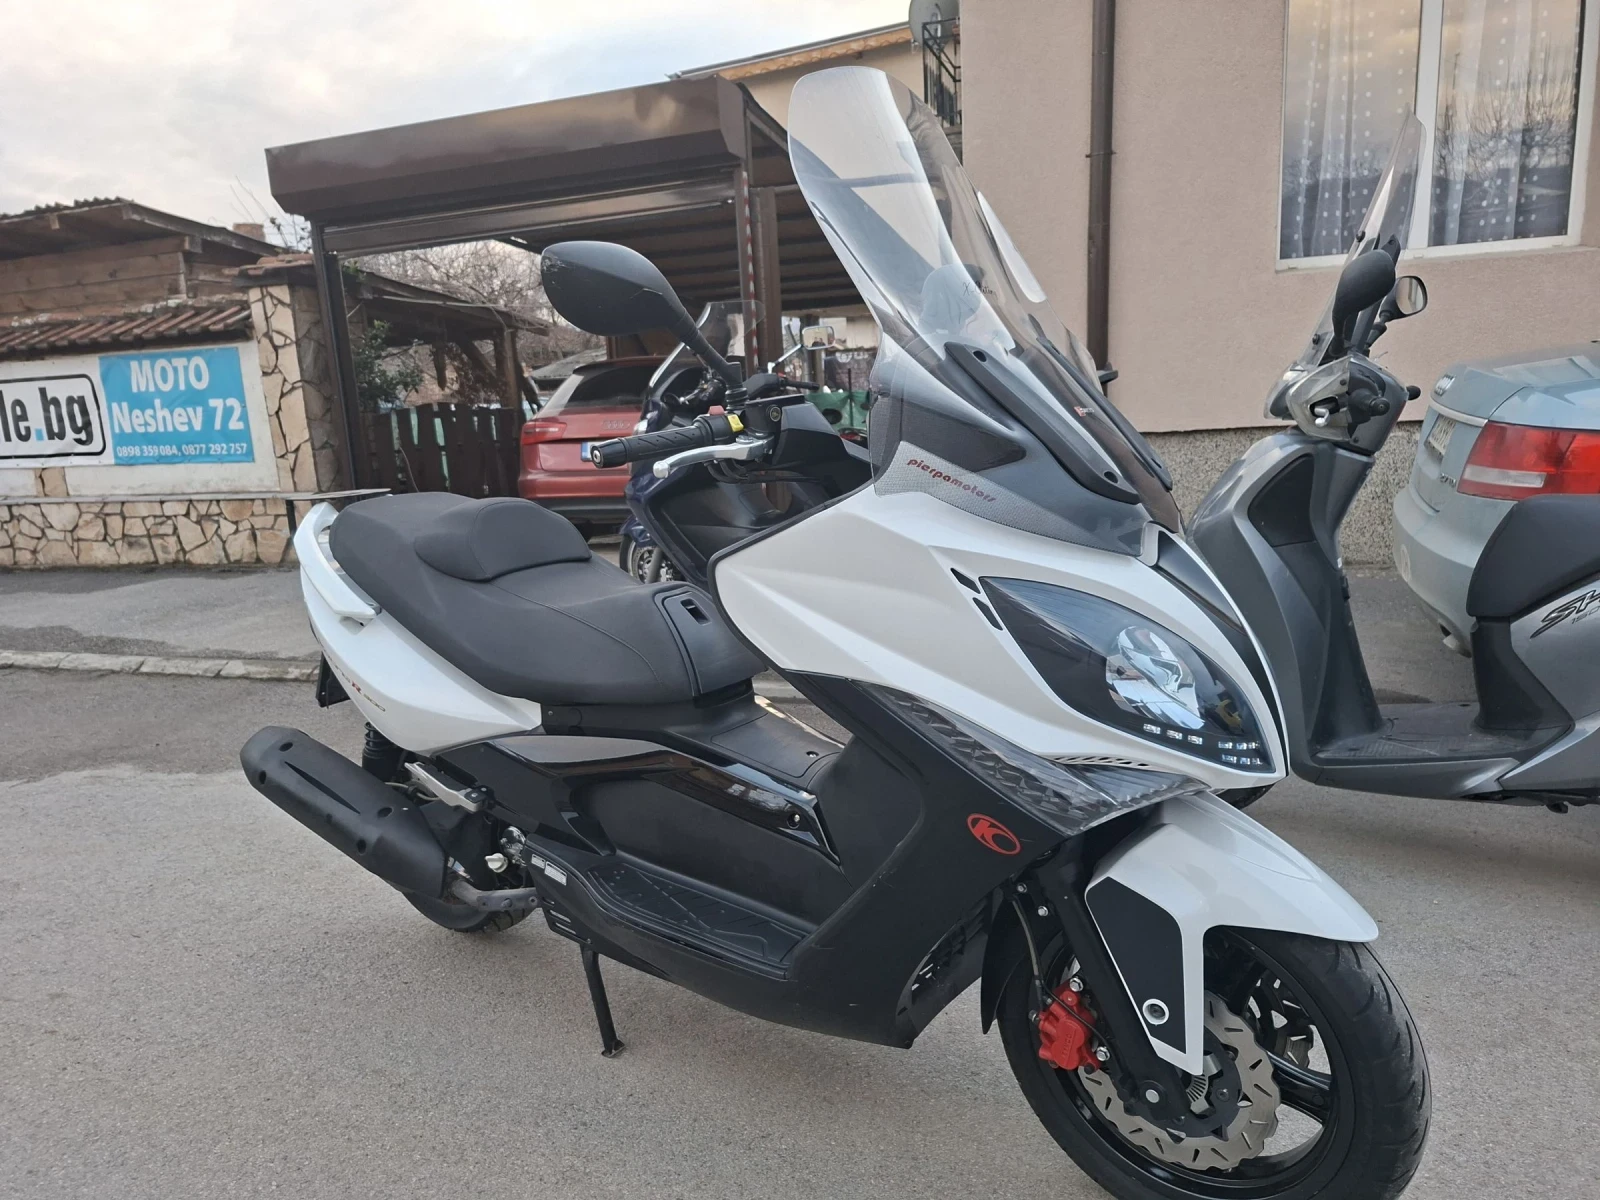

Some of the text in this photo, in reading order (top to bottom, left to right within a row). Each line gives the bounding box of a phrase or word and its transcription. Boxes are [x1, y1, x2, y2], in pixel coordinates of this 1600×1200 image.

[130, 356, 209, 393] MOTO
[112, 398, 245, 433] Neshev 72
[116, 446, 140, 457] 0898
[142, 445, 158, 456] 359
[182, 444, 206, 455] 0877
[208, 443, 227, 455] 292
[229, 442, 247, 454] 757
[907, 459, 996, 502] pierpamotors
